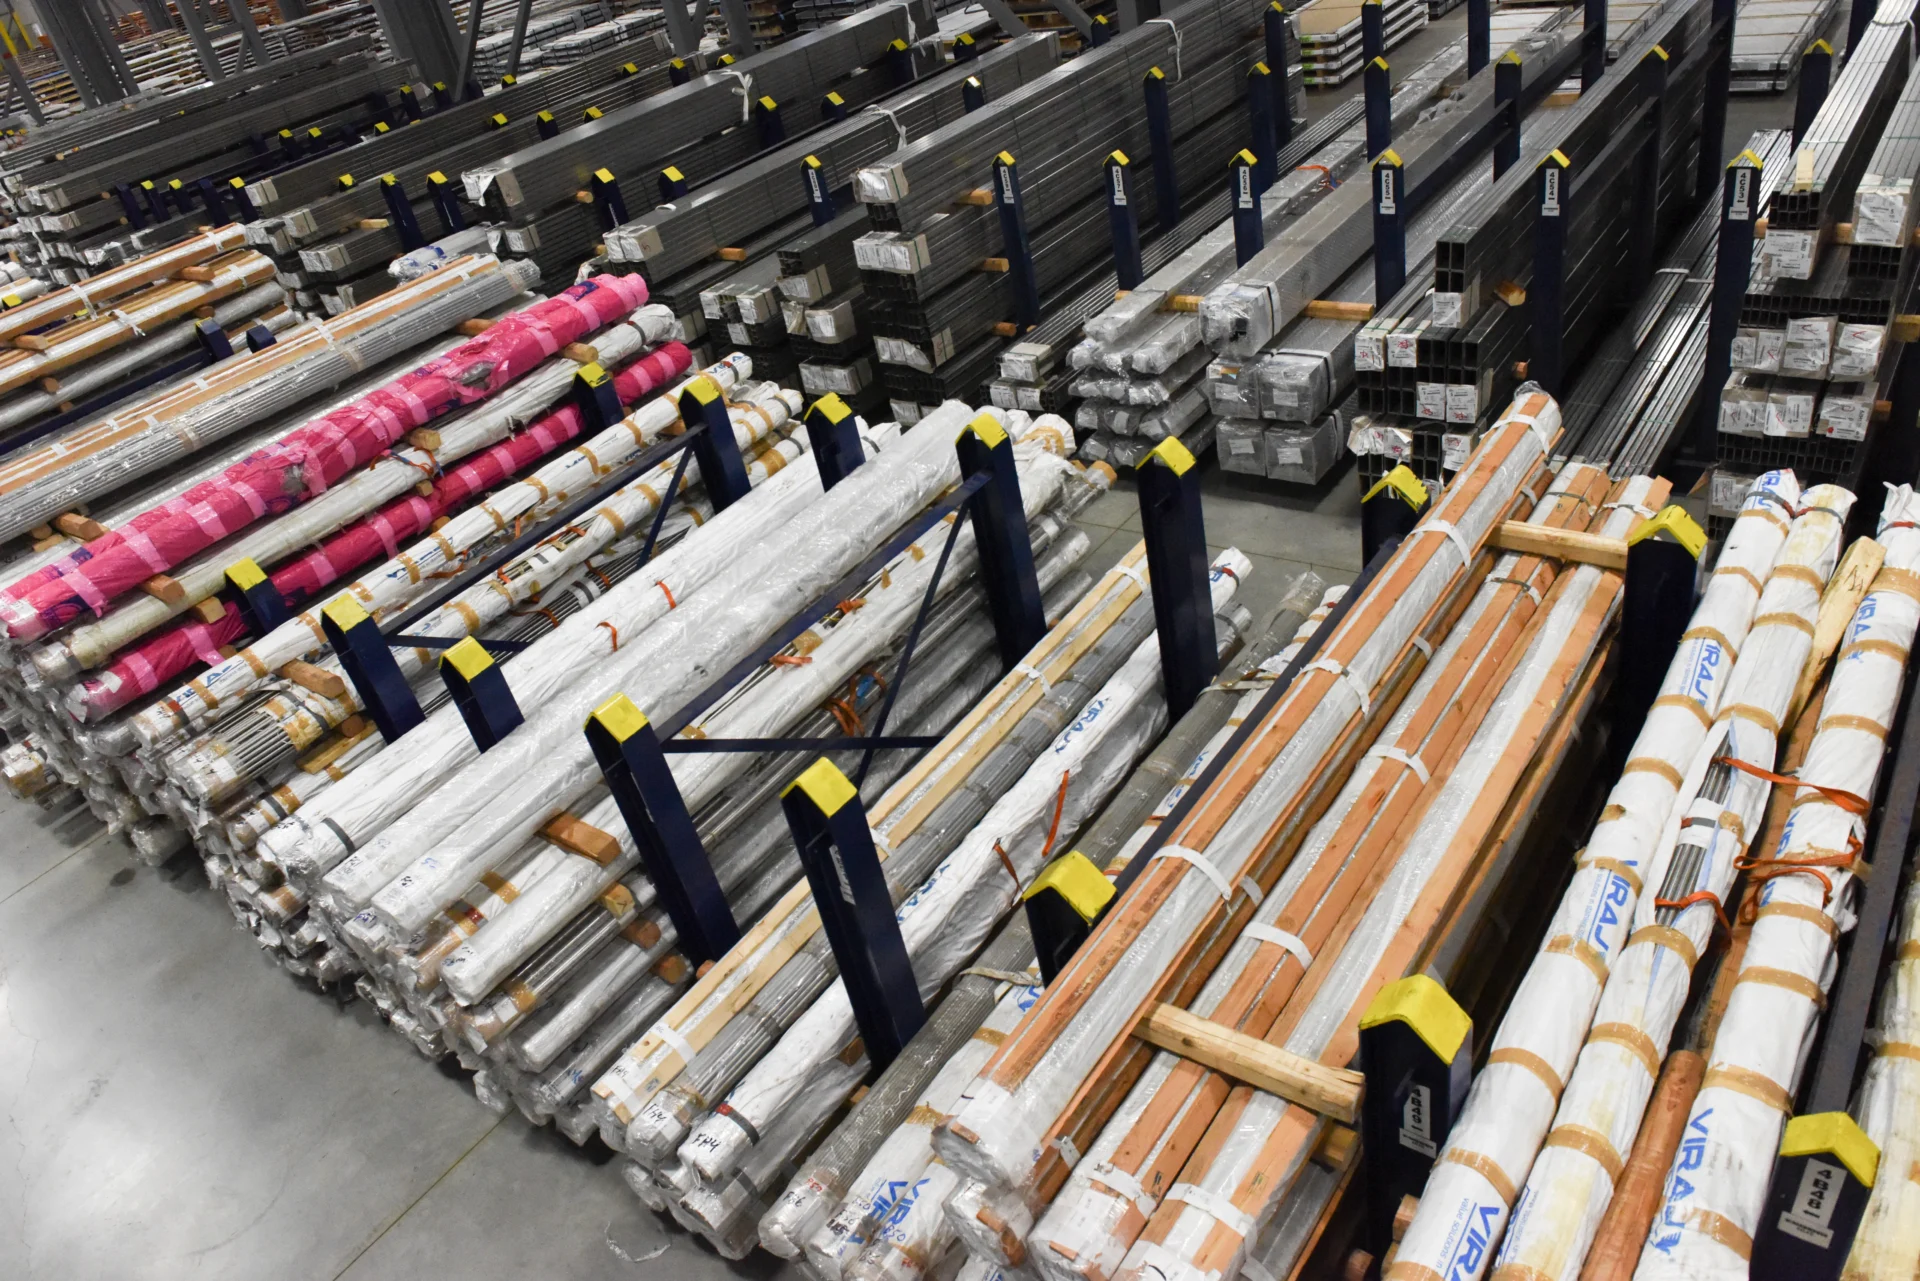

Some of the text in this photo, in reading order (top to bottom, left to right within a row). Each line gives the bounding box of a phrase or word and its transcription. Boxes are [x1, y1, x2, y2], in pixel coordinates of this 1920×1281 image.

[1695, 644, 1722, 700] IRAJ
[1595, 861, 1638, 952] IRAJ
[1664, 1108, 1714, 1229] VIRAJ
[1435, 1198, 1470, 1269] value solutions in
